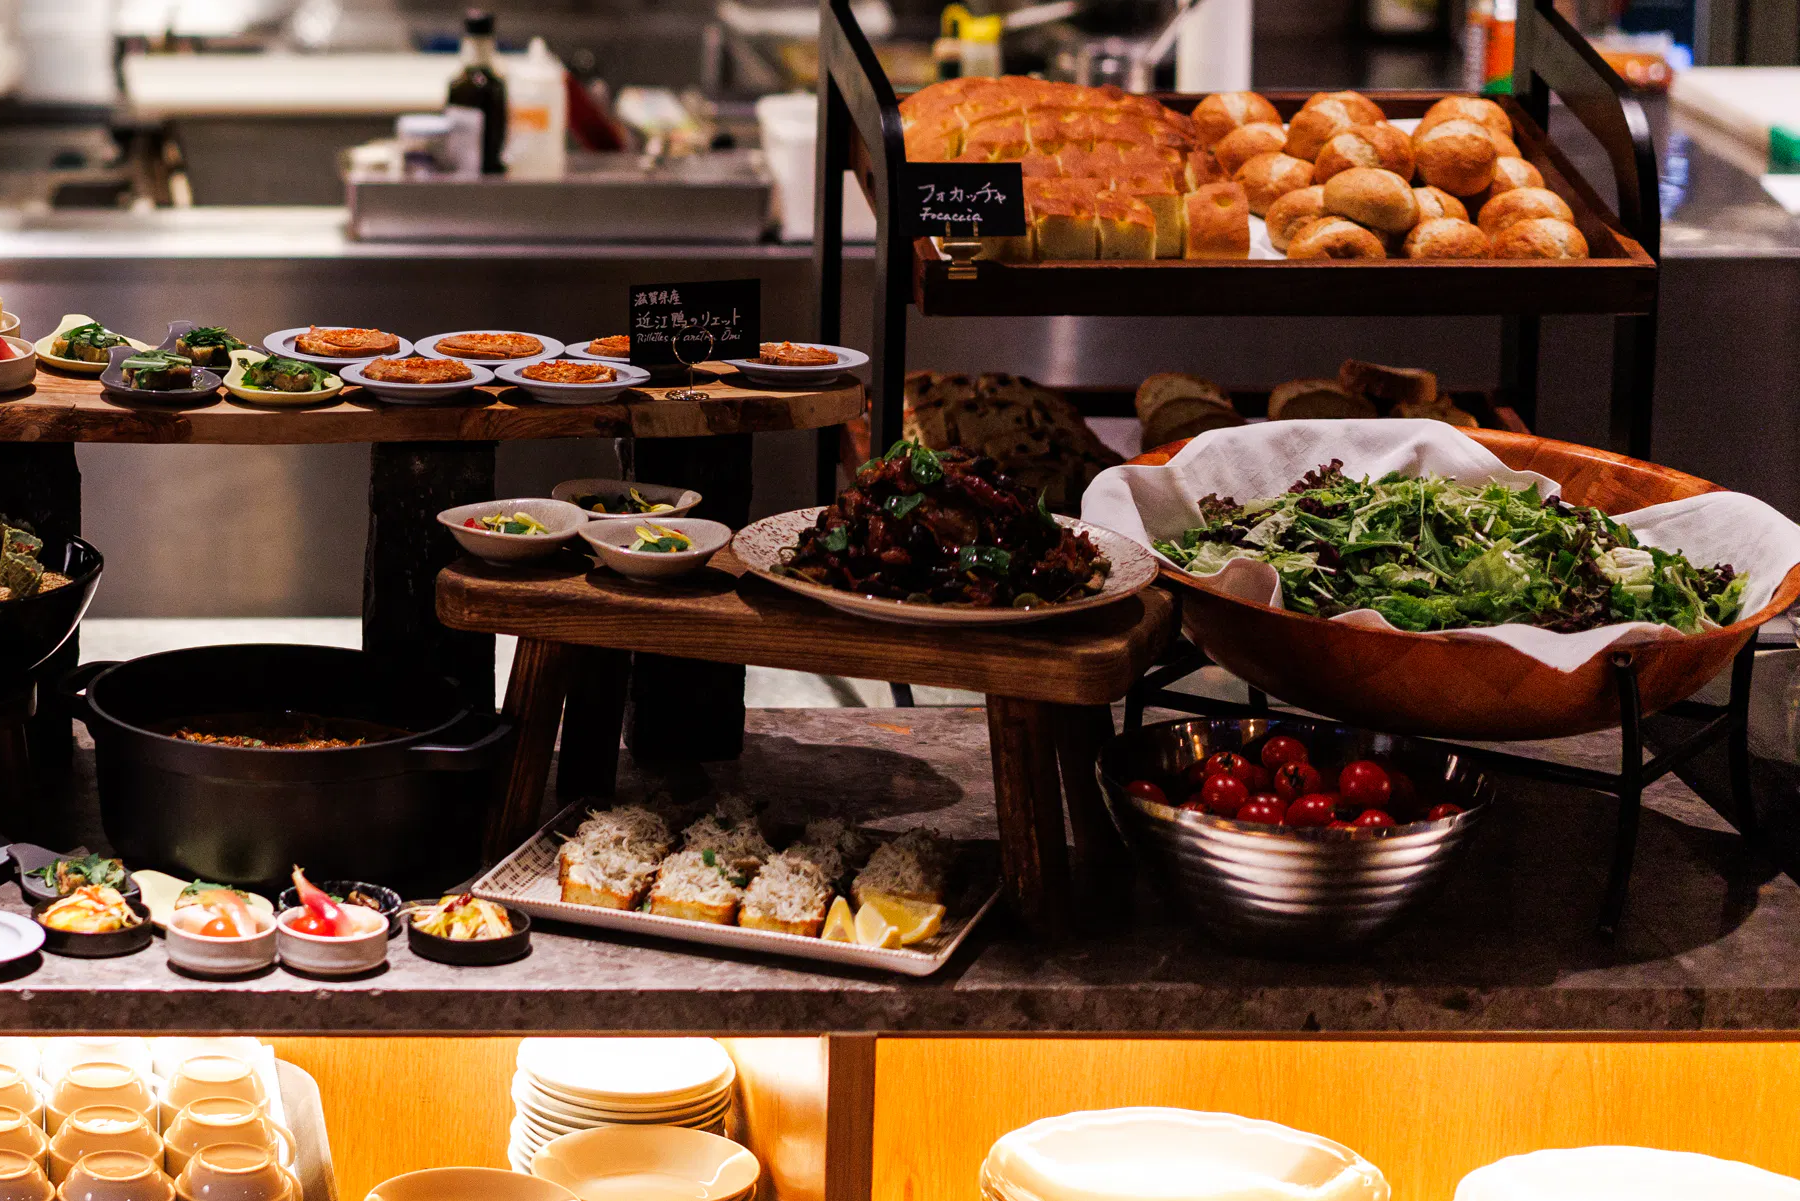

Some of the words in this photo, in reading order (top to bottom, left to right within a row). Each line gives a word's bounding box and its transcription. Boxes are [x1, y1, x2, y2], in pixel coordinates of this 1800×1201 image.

[917, 181, 1007, 204] フォカッチャ
[919, 206, 984, 222] Focaccia
[633, 288, 683, 307] 滋賀県産
